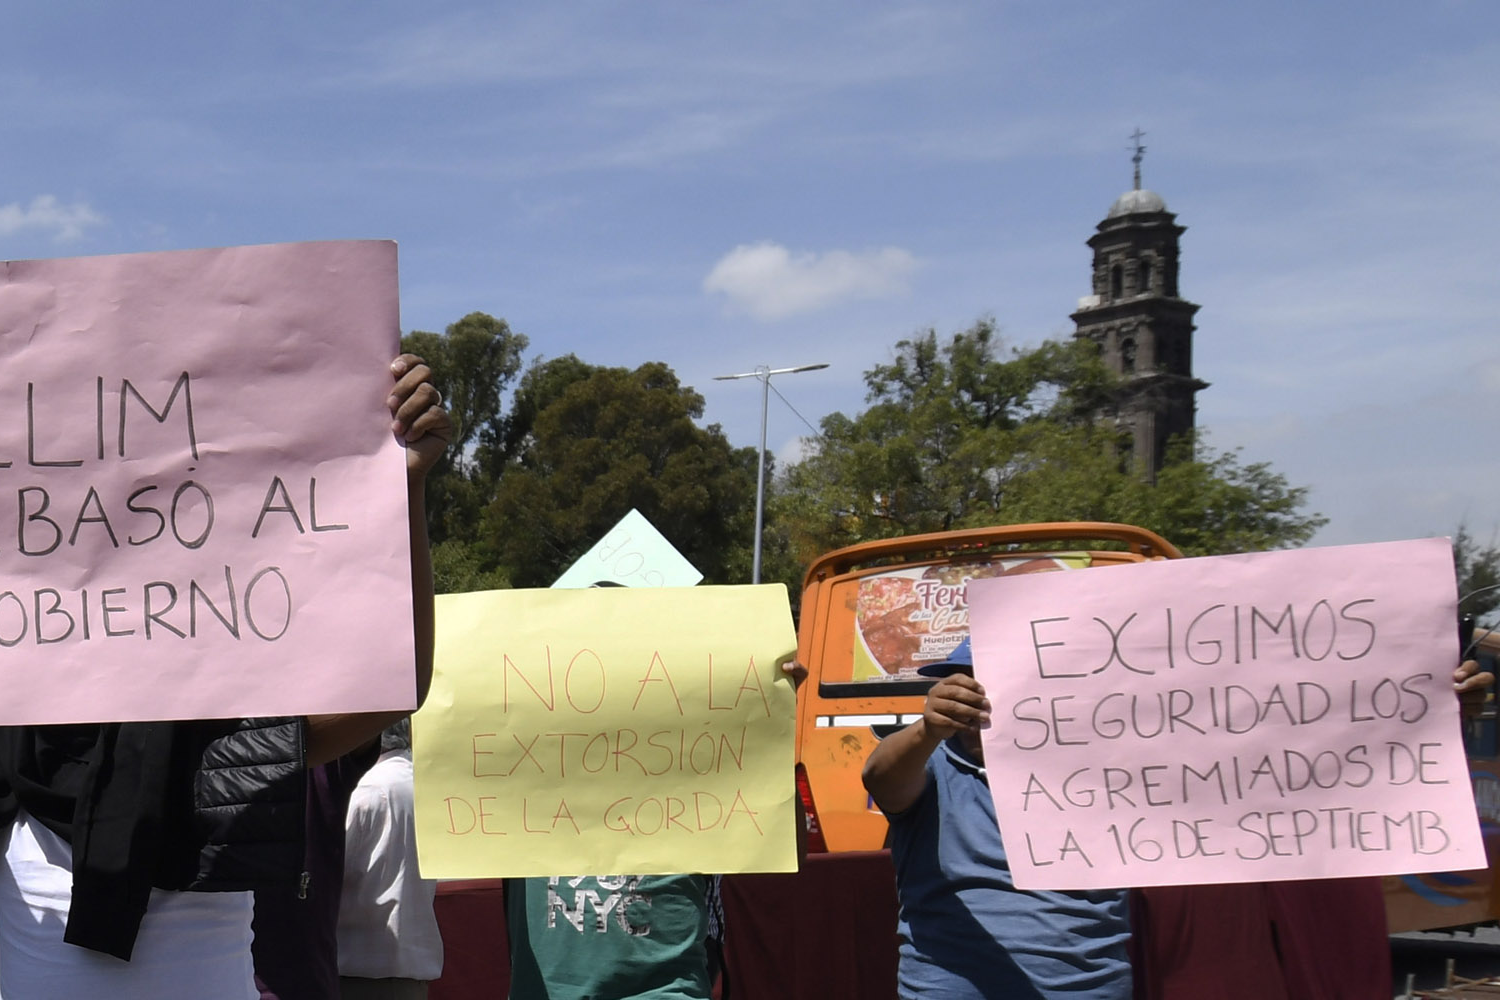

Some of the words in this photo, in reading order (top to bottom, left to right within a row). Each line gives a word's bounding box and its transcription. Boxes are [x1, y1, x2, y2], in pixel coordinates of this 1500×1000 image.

[252, 476, 349, 538] AL
[1030, 599, 1376, 679] EXIGIMOS
[502, 645, 606, 715] NO
[632, 650, 684, 716] A
[708, 653, 771, 718] LA
[1012, 681, 1331, 751] SEGURIDAD
[1349, 673, 1434, 724] LOS
[1022, 745, 1374, 813] AGREMIADOS
[1386, 742, 1450, 786] DE
[444, 796, 507, 836] DE
[522, 798, 580, 835] LA
[603, 789, 764, 837] GORDA
[1025, 830, 1093, 869] LA
[1107, 818, 1164, 866] 16
[1173, 818, 1225, 860] DE
[547, 889, 652, 936] NYC
